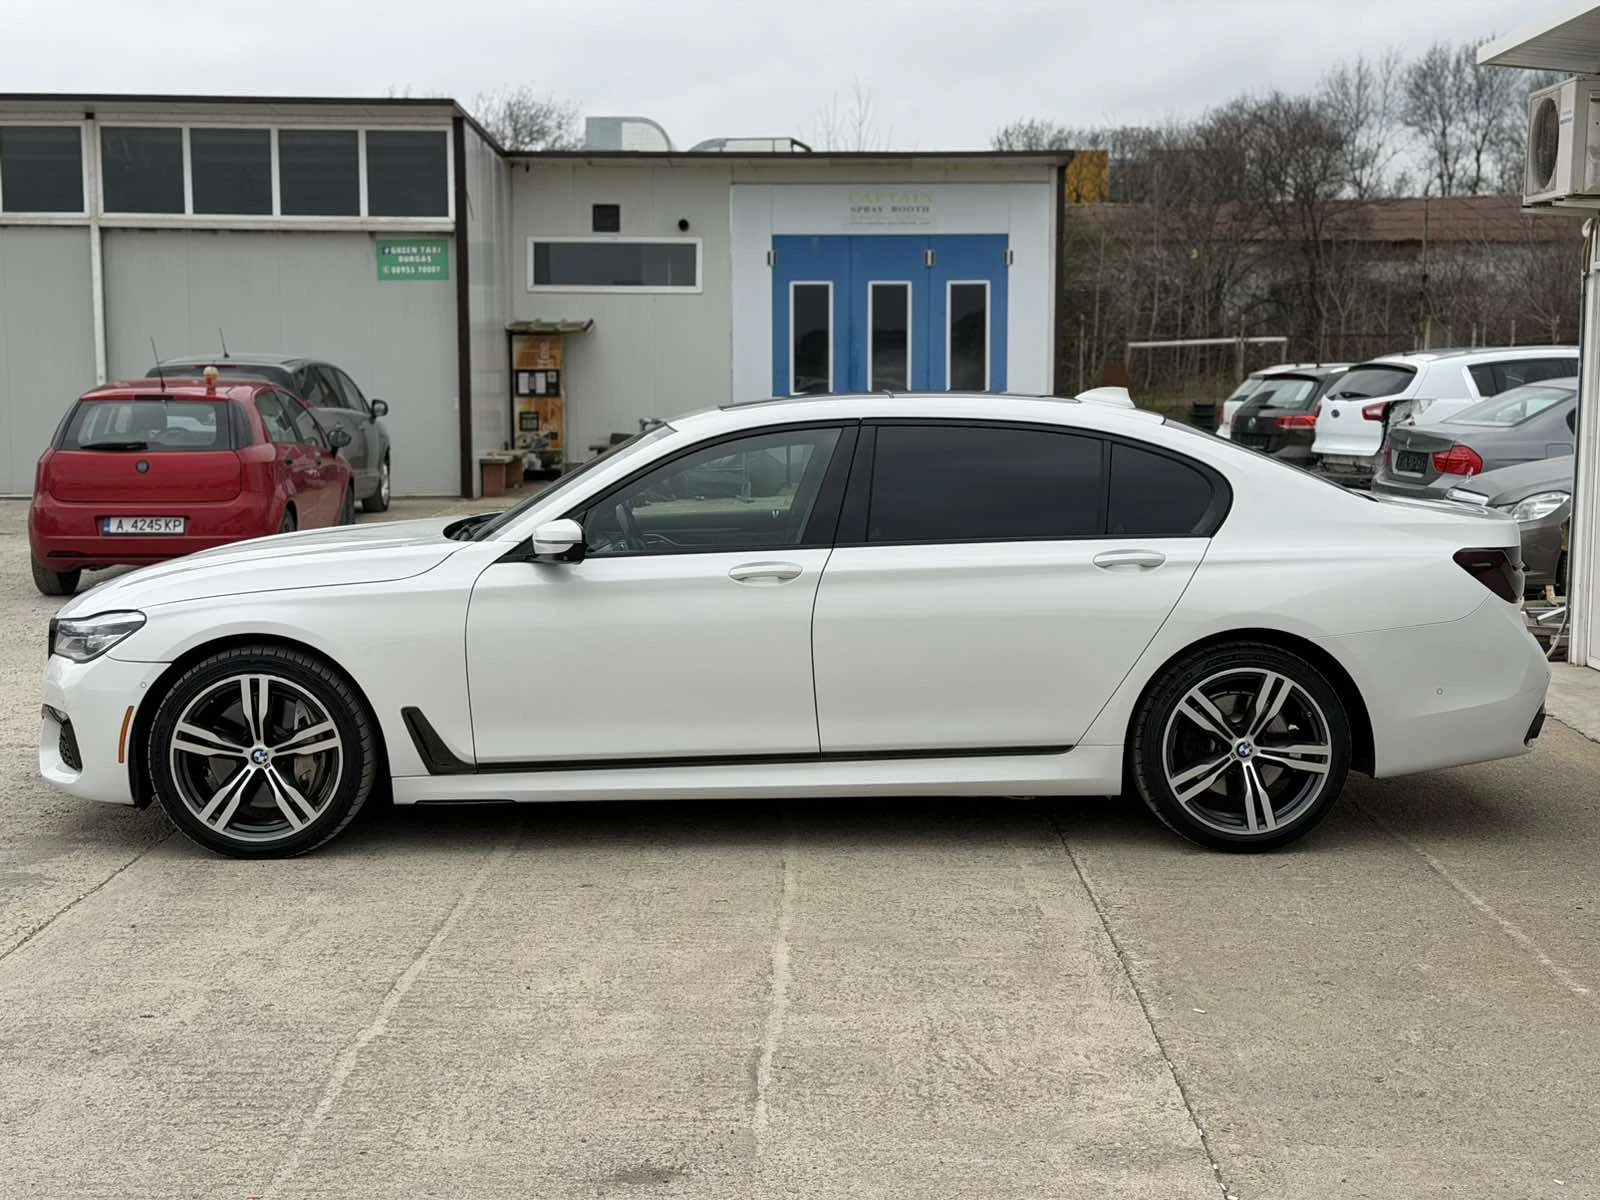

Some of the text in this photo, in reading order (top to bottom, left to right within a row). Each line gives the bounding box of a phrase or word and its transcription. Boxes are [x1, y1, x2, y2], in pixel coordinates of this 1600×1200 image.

[891, 205, 930, 214] BOOTH
[390, 246, 418, 255] GREEN
[398, 255, 432, 264] BURGAS
[116, 518, 182, 531] A 4245 KP
